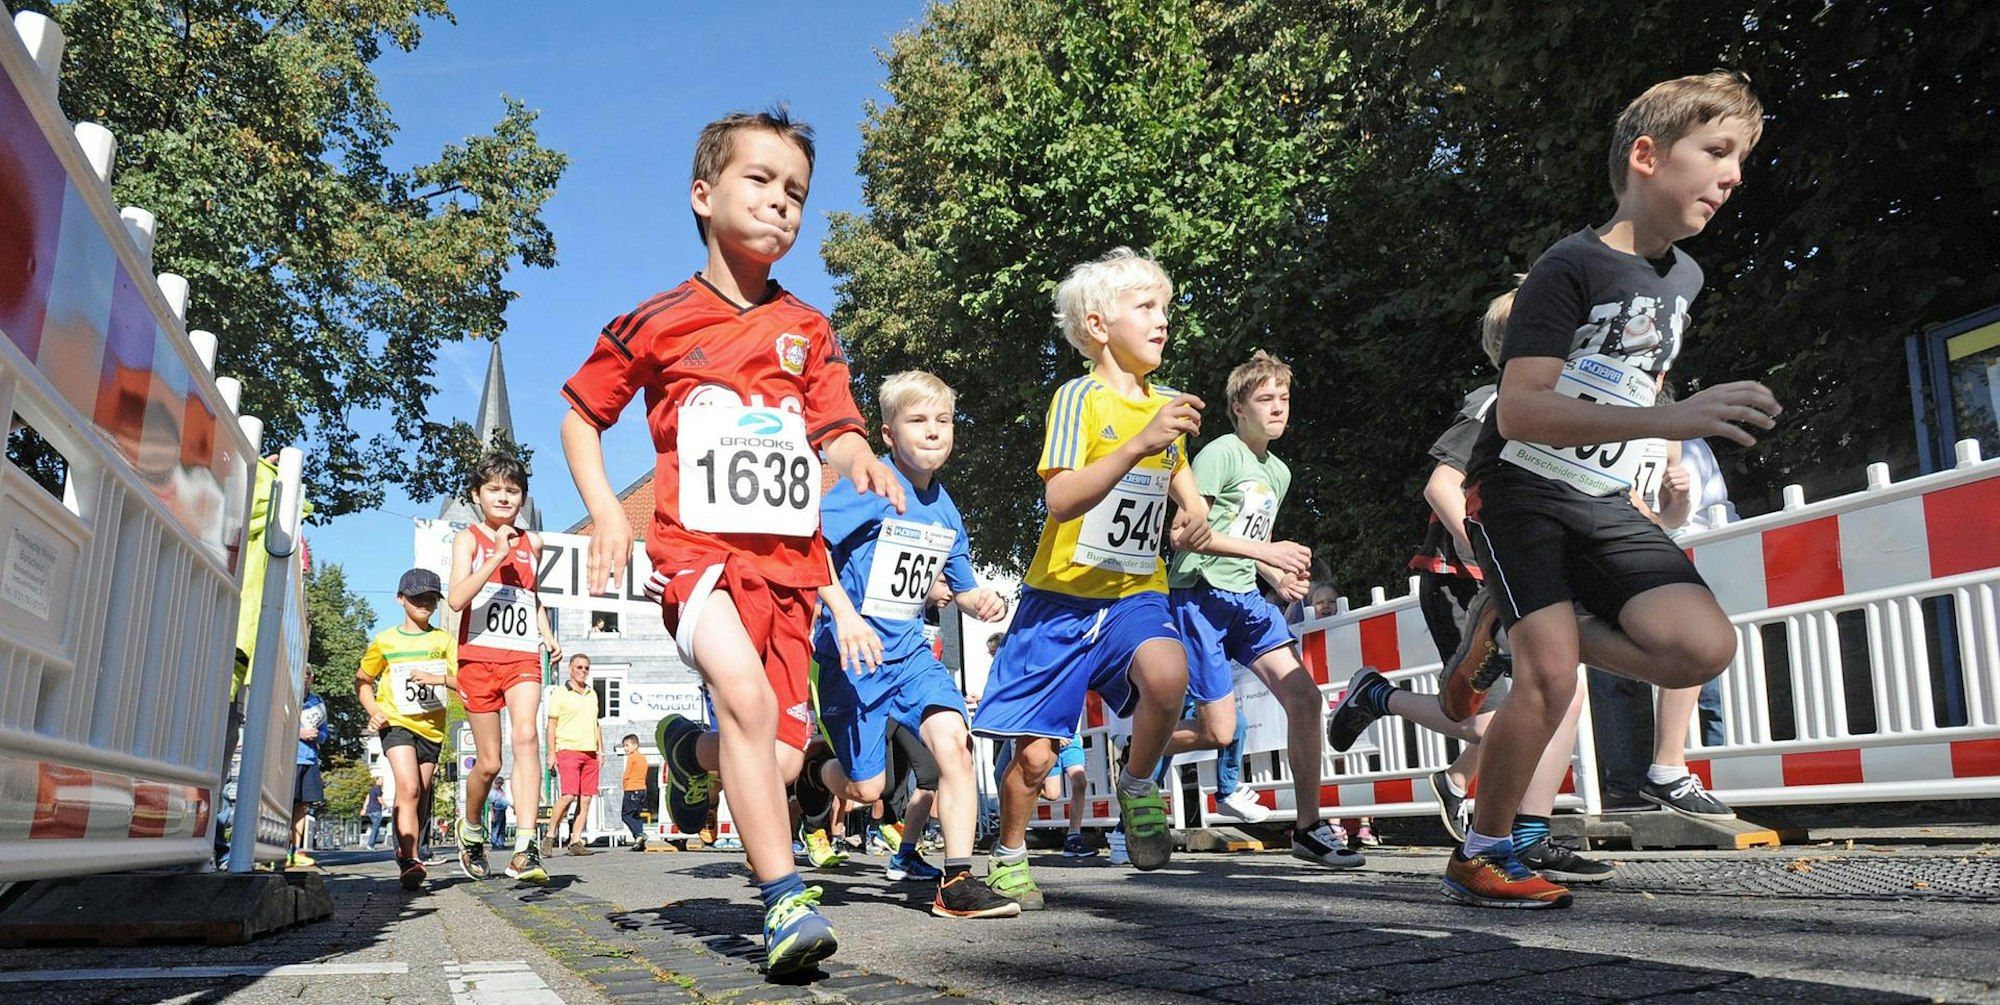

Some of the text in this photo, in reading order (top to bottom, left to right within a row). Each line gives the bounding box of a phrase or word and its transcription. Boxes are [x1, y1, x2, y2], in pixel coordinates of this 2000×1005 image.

[720, 436, 794, 451] BROOKS
[697, 449, 810, 510] 1638
[1122, 472, 1150, 485] OBRA
[1516, 448, 1577, 480] Burscheider
[1107, 498, 1164, 551] 549
[538, 544, 648, 601] ZIL
[891, 551, 938, 599] 565
[1086, 551, 1139, 568] Burscheider
[486, 603, 527, 636] 608
